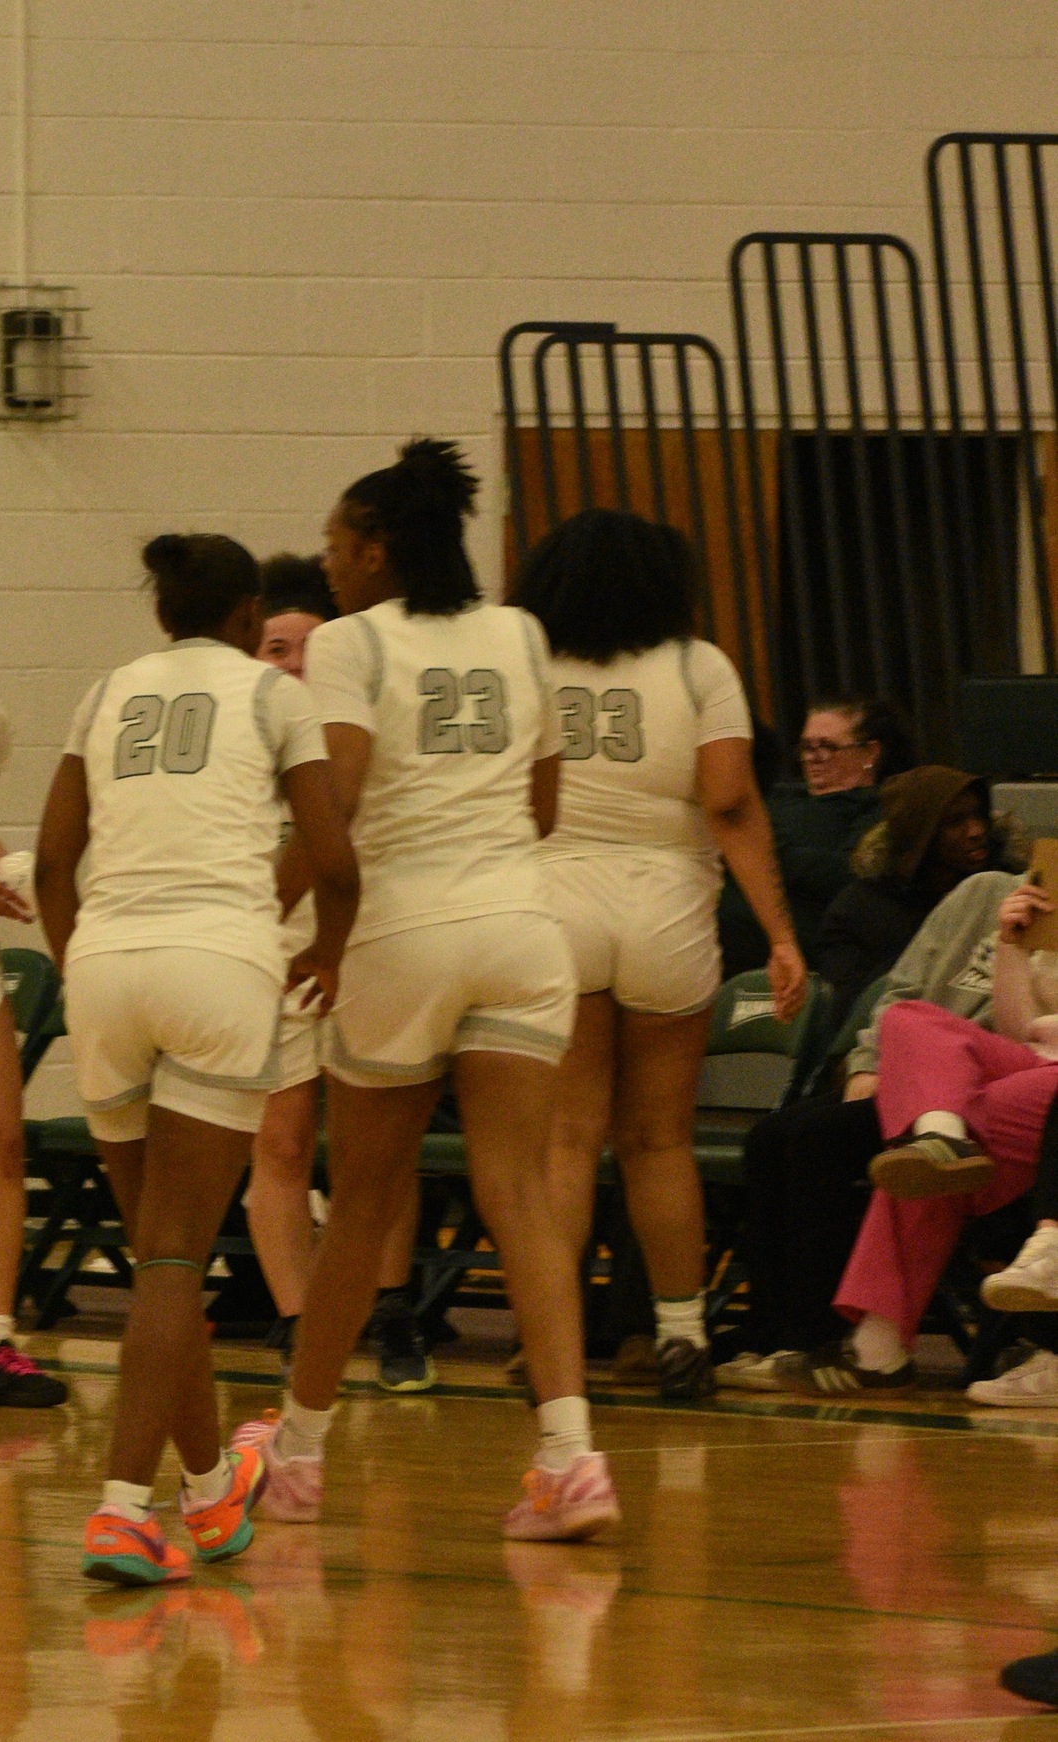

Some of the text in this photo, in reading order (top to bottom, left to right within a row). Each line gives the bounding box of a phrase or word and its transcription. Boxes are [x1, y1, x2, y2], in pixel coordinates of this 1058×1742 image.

[113, 692, 215, 779] 20
[418, 667, 511, 754] 23
[555, 686, 645, 762] 33
